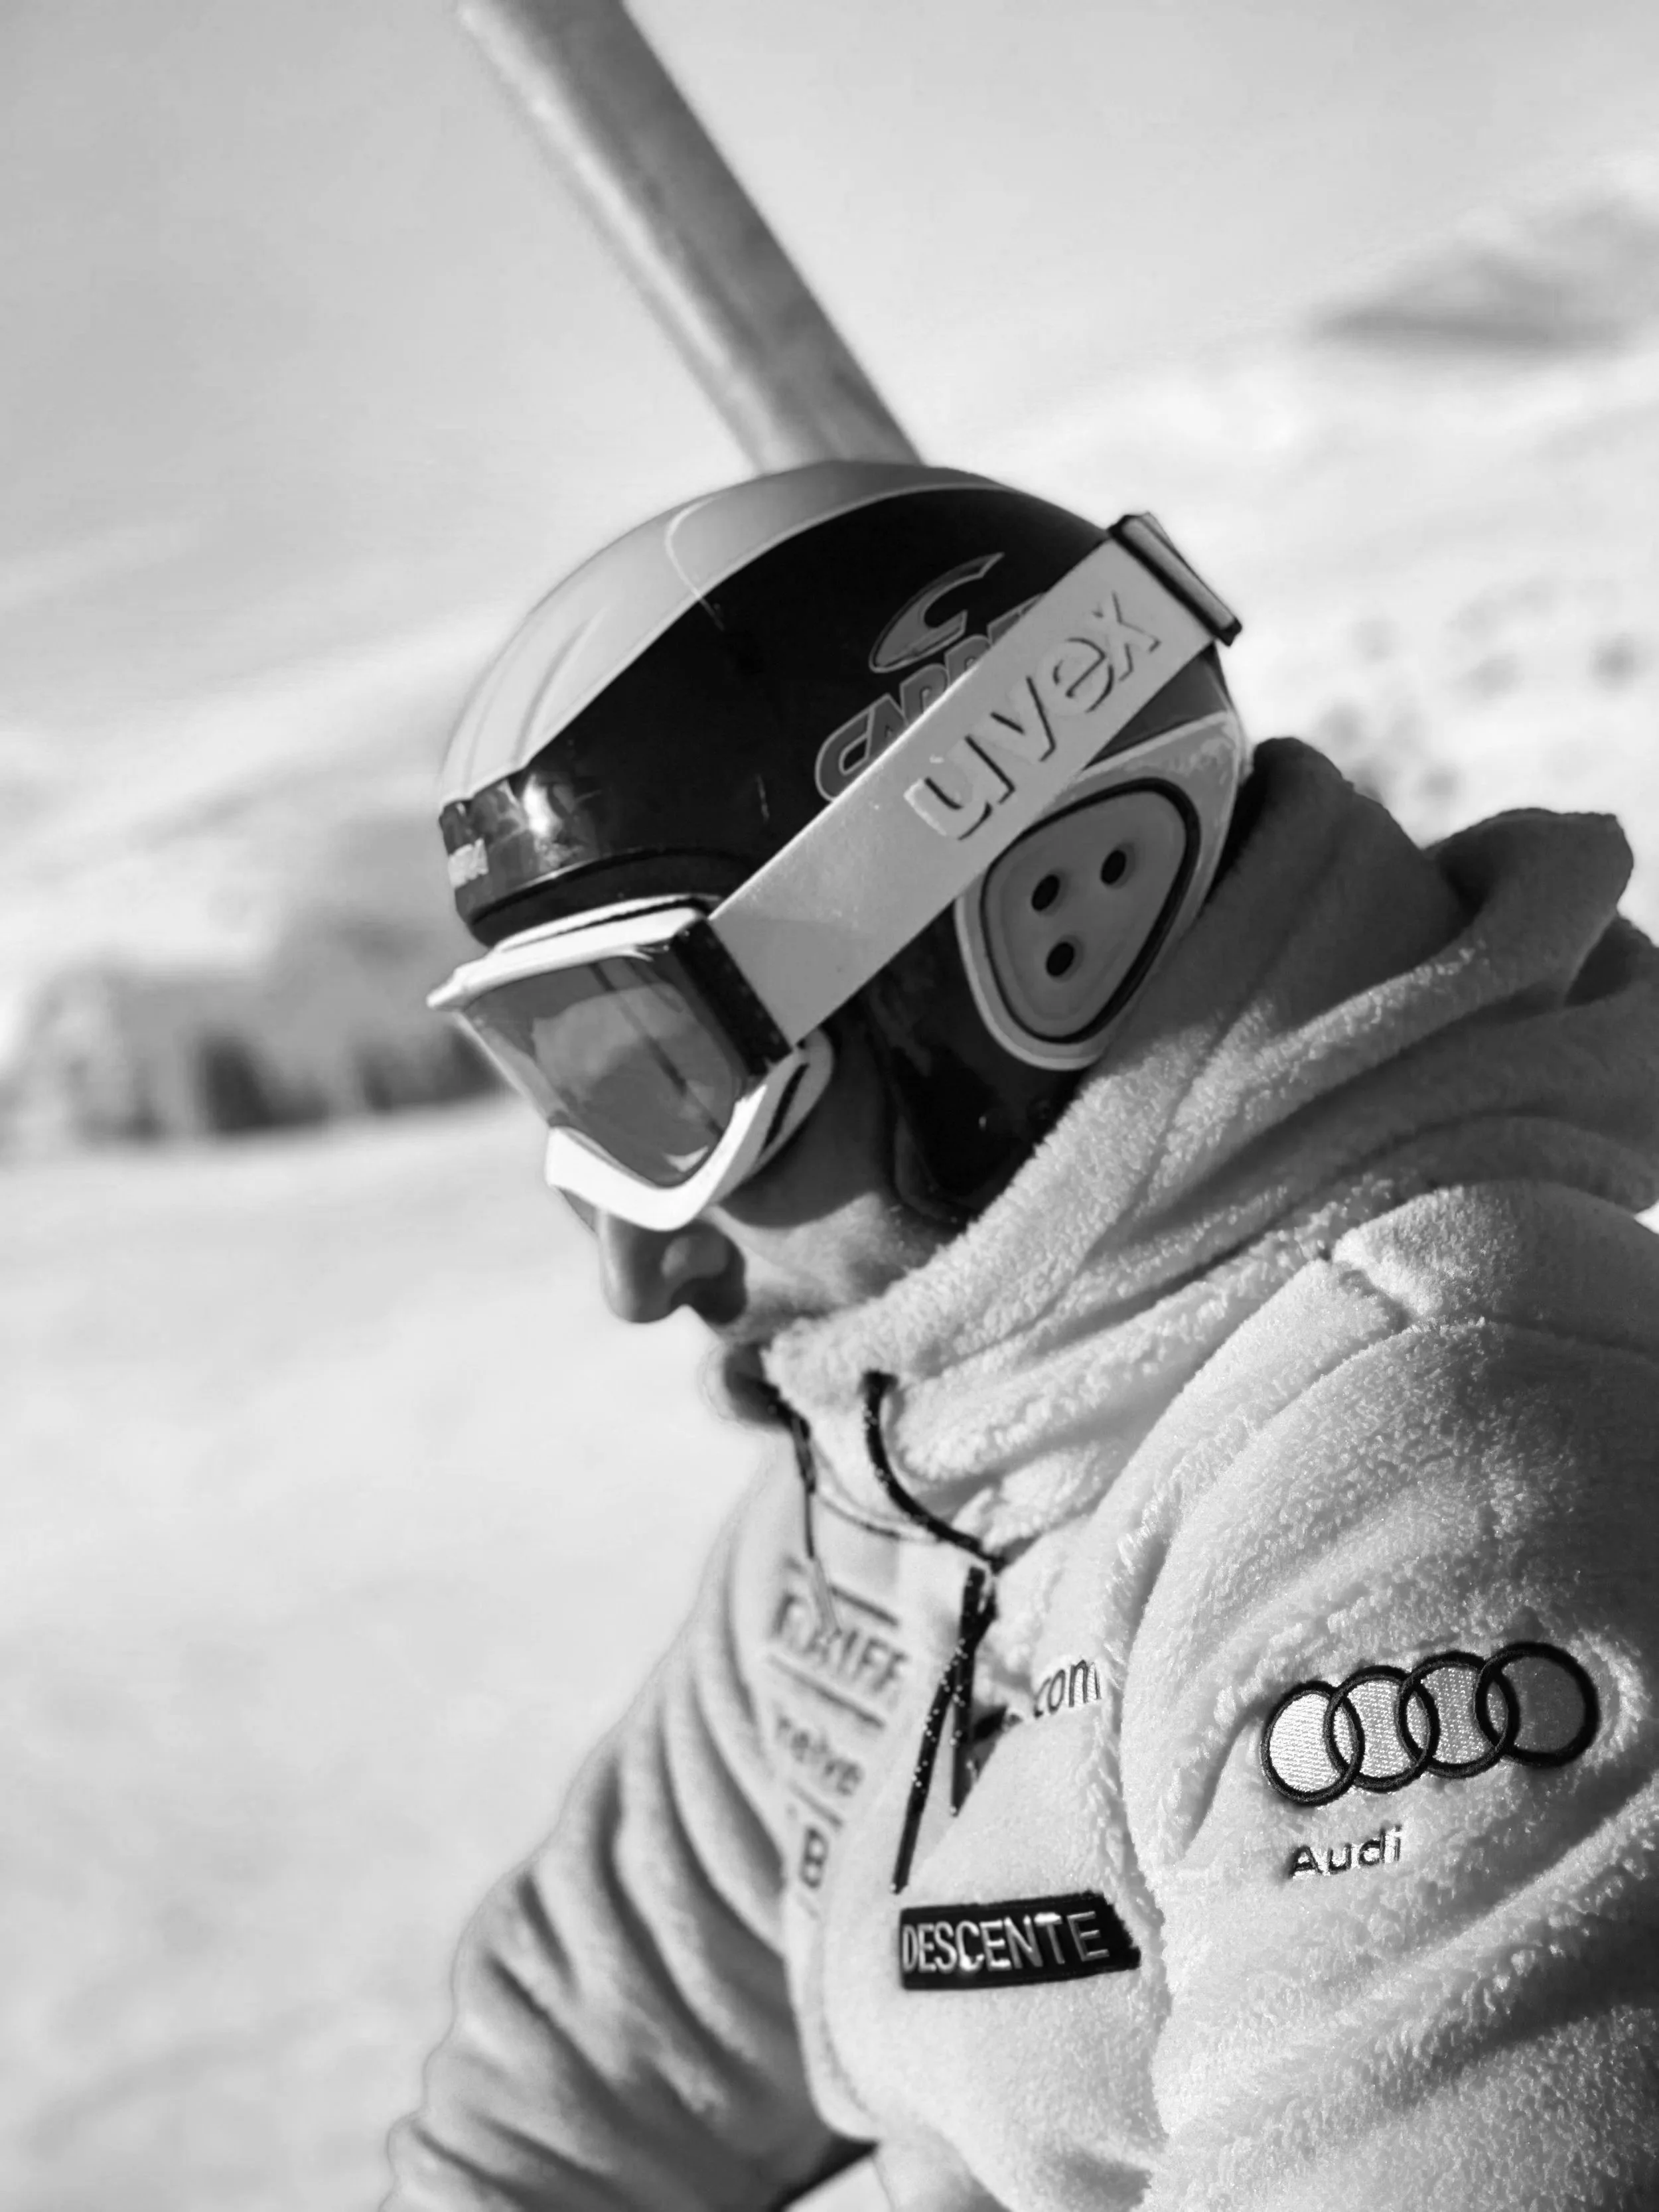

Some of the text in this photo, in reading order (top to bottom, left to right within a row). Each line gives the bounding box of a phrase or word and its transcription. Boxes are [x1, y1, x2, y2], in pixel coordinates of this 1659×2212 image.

[903, 589, 1161, 842] uvex
[1287, 1821, 1403, 1880] Audi
[901, 1910, 1111, 1974] DESCENTE
